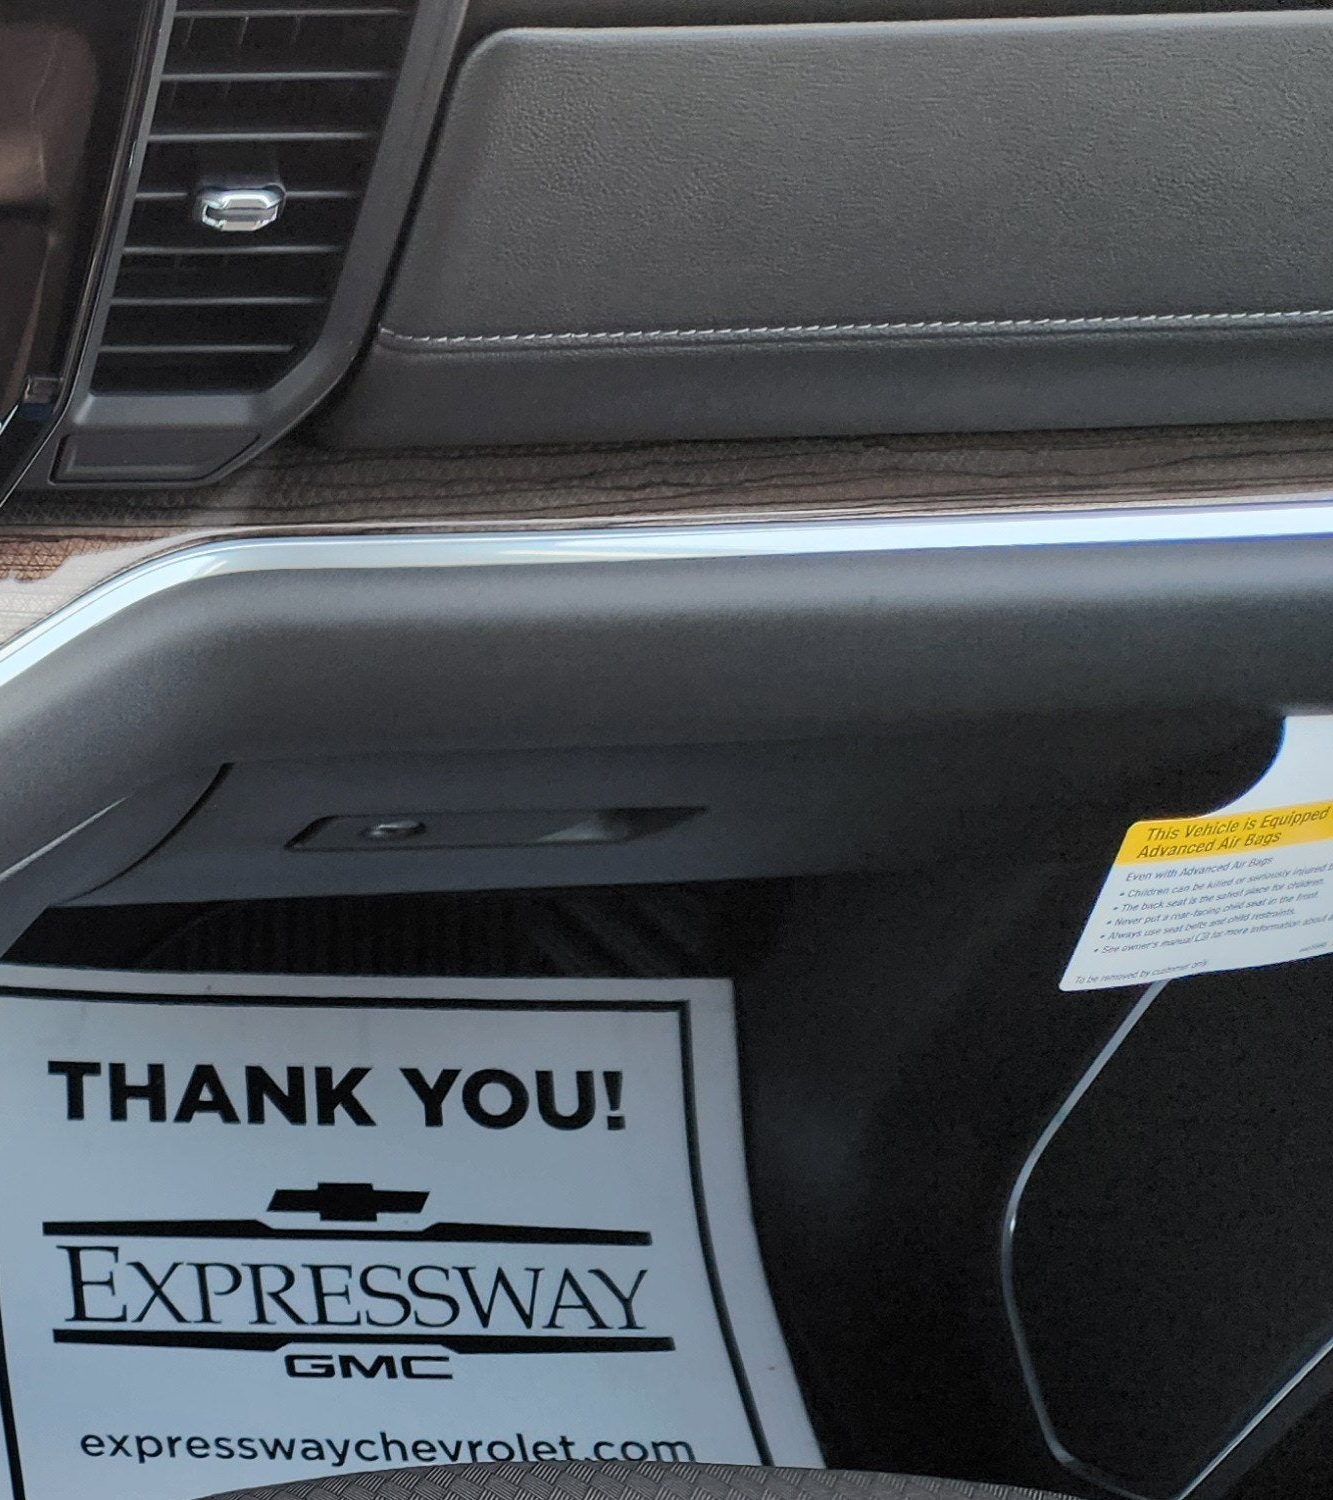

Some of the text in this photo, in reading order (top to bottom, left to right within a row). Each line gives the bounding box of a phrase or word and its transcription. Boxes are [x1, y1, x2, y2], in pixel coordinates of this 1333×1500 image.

[1147, 805, 1332, 842] This Vehicle is Equipped
[1136, 831, 1283, 860] Advanced Air Bags
[1126, 871, 1154, 882] Even
[1155, 868, 1179, 879] with
[1179, 862, 1232, 877] Advanced
[1231, 859, 1247, 870] Air
[1128, 886, 1170, 898] Children
[47, 1060, 626, 1132] THANK YOU!
[284, 1353, 454, 1380] GMC
[80, 1431, 697, 1467] expresswaychevrolet.com
